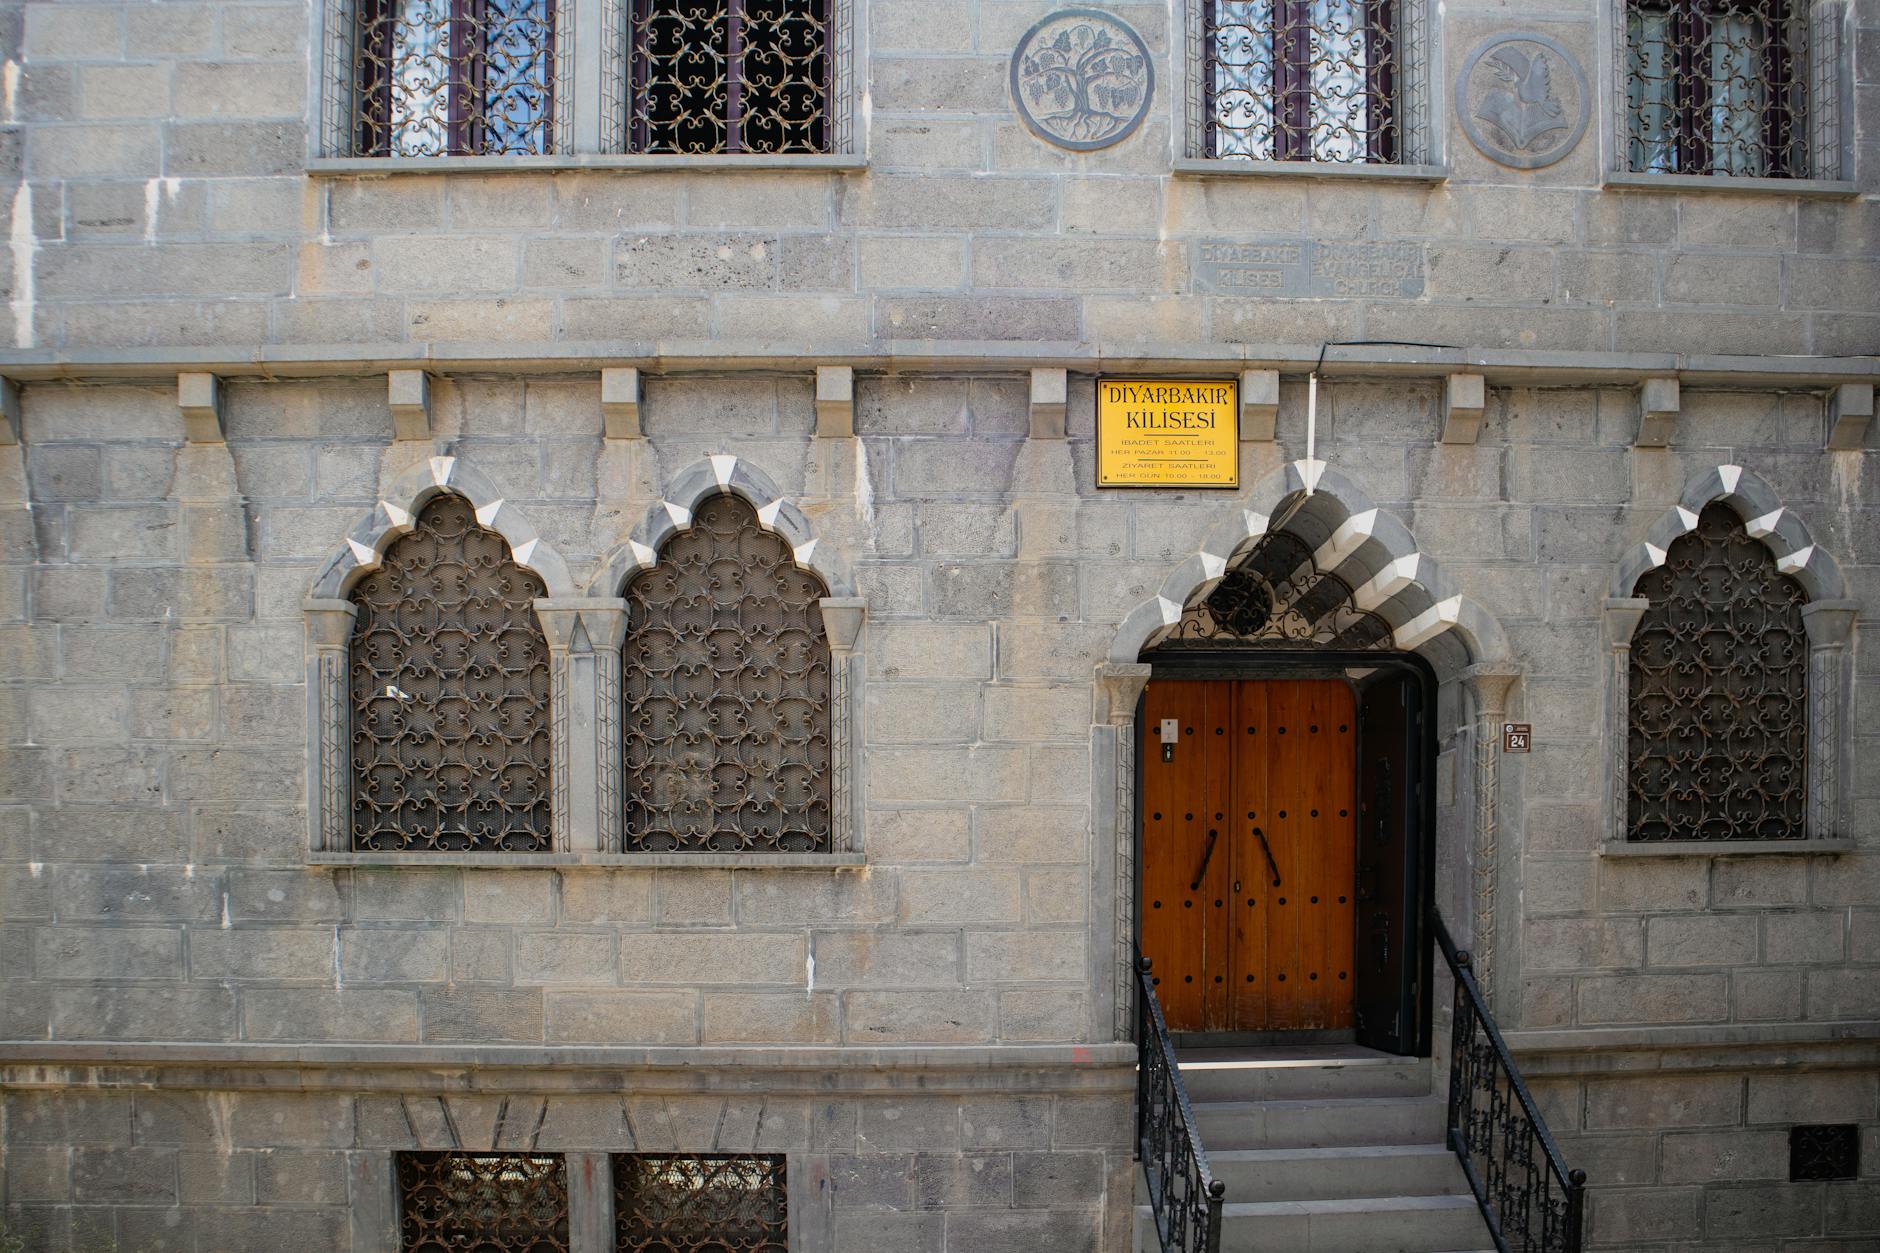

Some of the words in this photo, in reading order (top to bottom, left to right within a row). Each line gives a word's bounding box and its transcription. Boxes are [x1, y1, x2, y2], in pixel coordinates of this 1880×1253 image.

[1110, 384, 1228, 405] DİYARBAKIR
[1127, 409, 1216, 429] KİLİSESİ
[1511, 735, 1524, 747] 24
